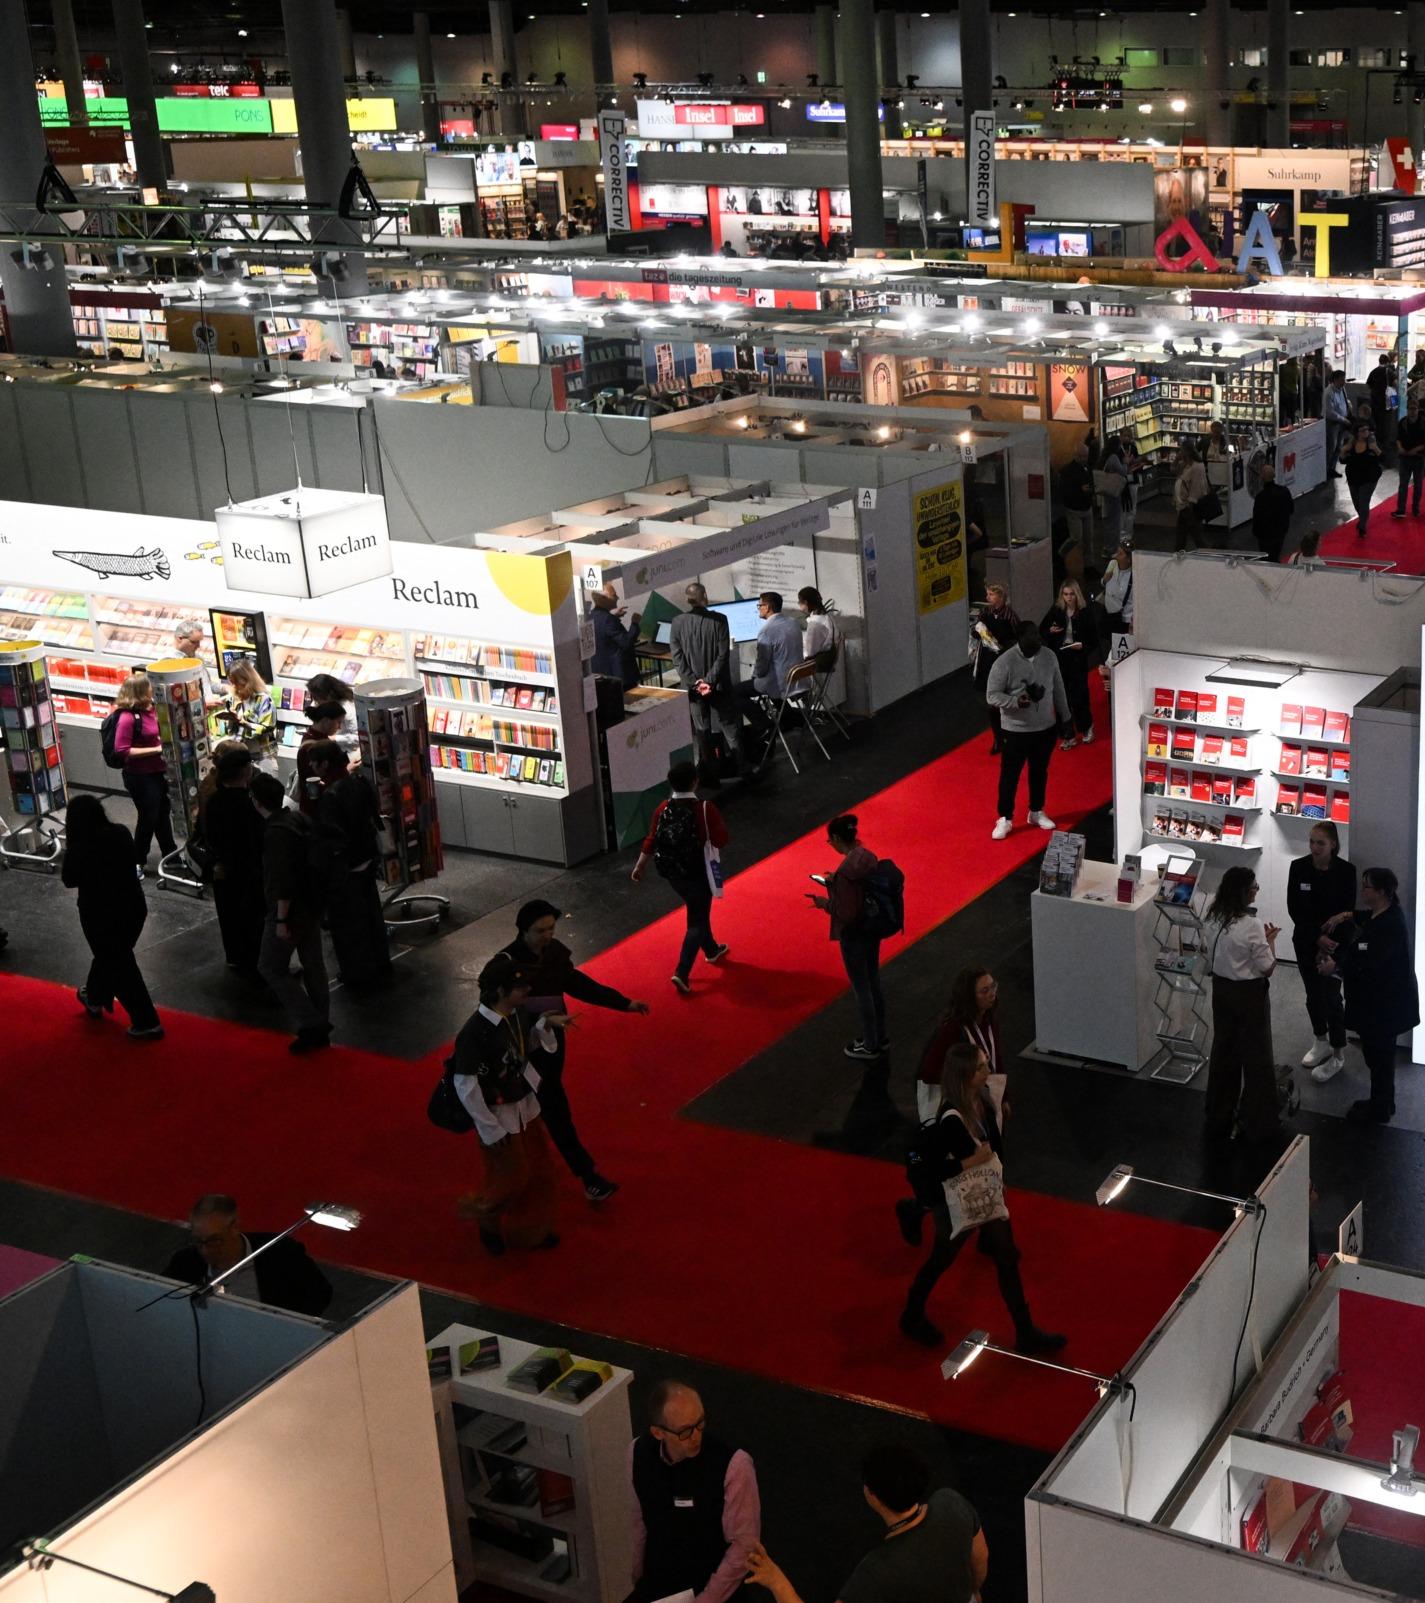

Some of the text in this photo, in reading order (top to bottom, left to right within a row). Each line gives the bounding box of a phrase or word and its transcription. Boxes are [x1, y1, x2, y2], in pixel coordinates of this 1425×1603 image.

[234, 109, 264, 122] PONS
[685, 108, 715, 123] Insel
[734, 108, 756, 122] Insel
[810, 106, 846, 117] Suhrkam
[977, 139, 990, 221] CORRECTIV
[1267, 168, 1321, 182] Suhrkamp
[610, 144, 625, 228] CORRECTIV
[669, 273, 683, 282] die
[684, 273, 742, 286] tageszeitung
[1052, 365, 1086, 375] SNOW
[965, 447, 971, 456] B
[863, 490, 871, 500] A
[232, 542, 291, 565] Reclam
[318, 534, 377, 562] Reclam
[588, 568, 596, 579] A
[586, 580, 599, 588] 107
[391, 577, 480, 610] Reclam
[1118, 636, 1128, 650] A
[1117, 650, 1130, 659] 12
[1346, 1217, 1356, 1246] A
[1305, 1326, 1329, 1362] Germany
